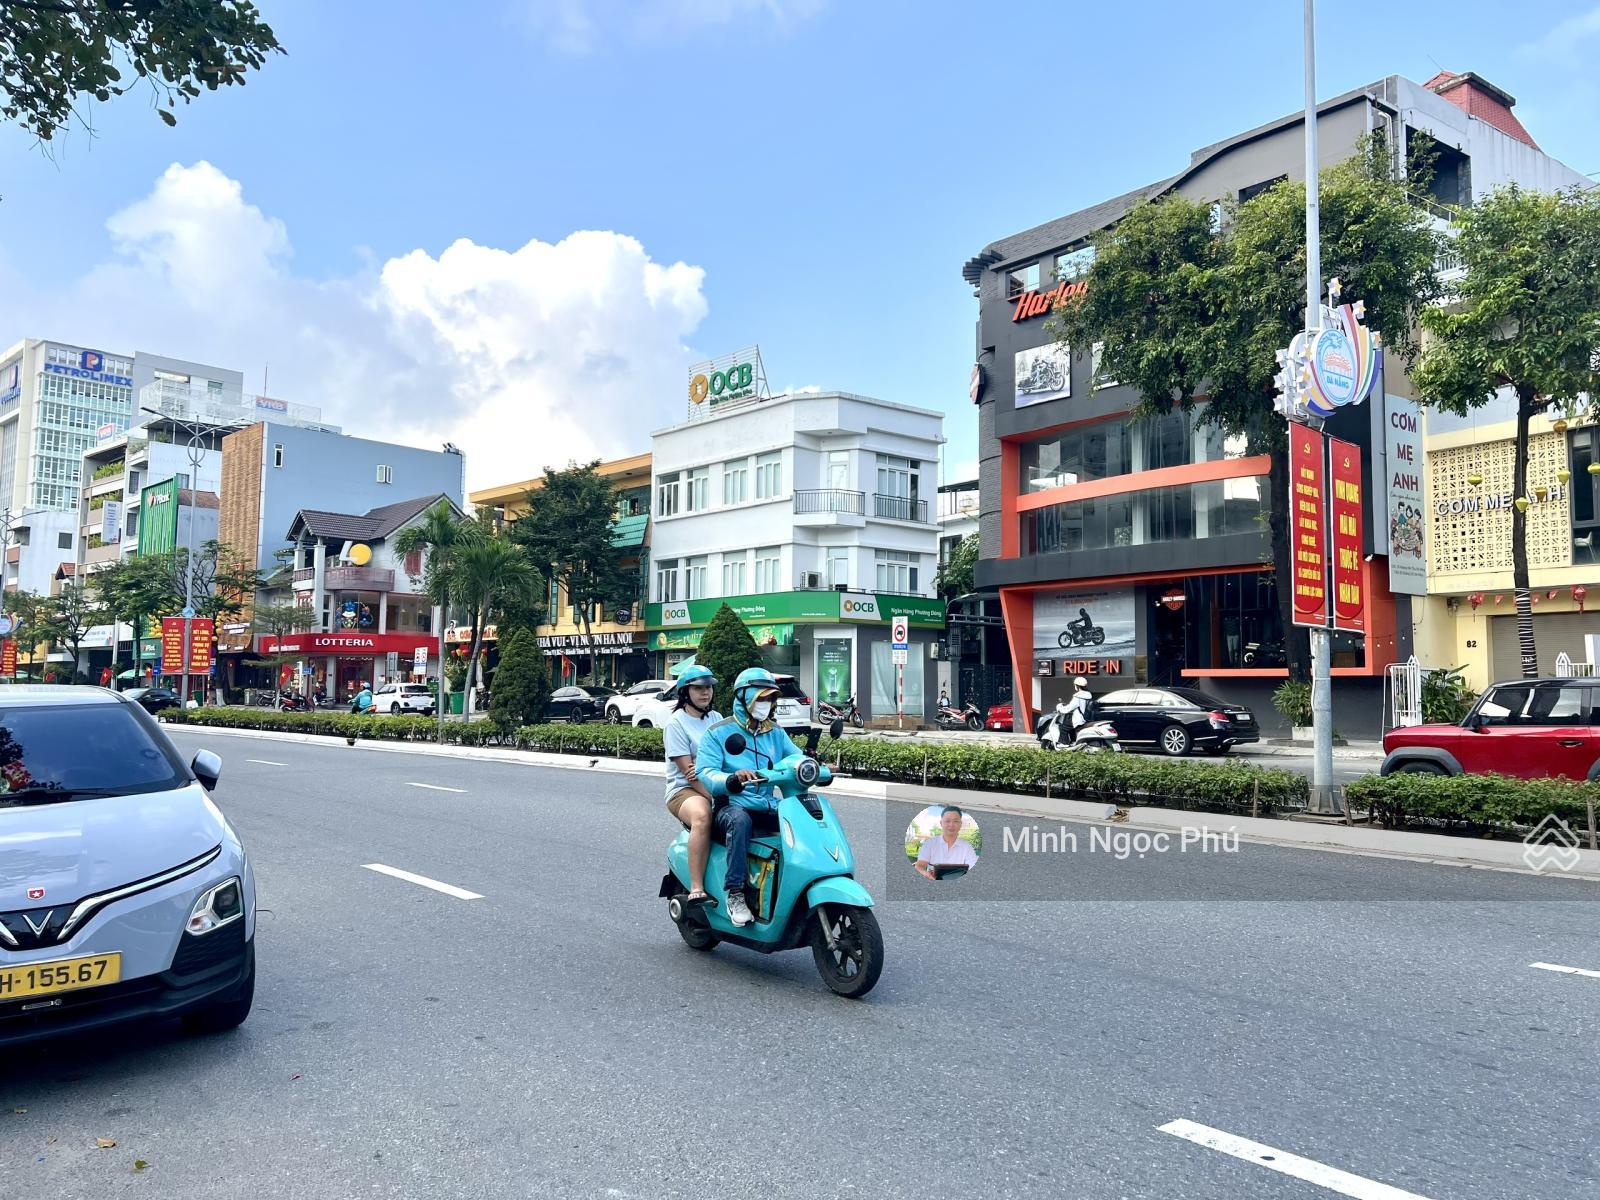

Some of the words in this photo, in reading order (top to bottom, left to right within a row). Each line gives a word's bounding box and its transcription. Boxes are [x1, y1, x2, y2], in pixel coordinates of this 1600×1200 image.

[44, 363, 134, 388] PETROLIMEX
[709, 362, 753, 396] OCB
[1391, 411, 1417, 433] CƠM
[1397, 443, 1413, 465] MẸ
[1393, 472, 1419, 492] ANH
[671, 609, 686, 618] OCB
[853, 602, 874, 612] OCB
[891, 607, 903, 615] Ngân
[903, 608, 914, 616] Hàng
[914, 609, 930, 617] Phương
[315, 638, 374, 647] LOTTERIA
[1466, 640, 1477, 648] 82
